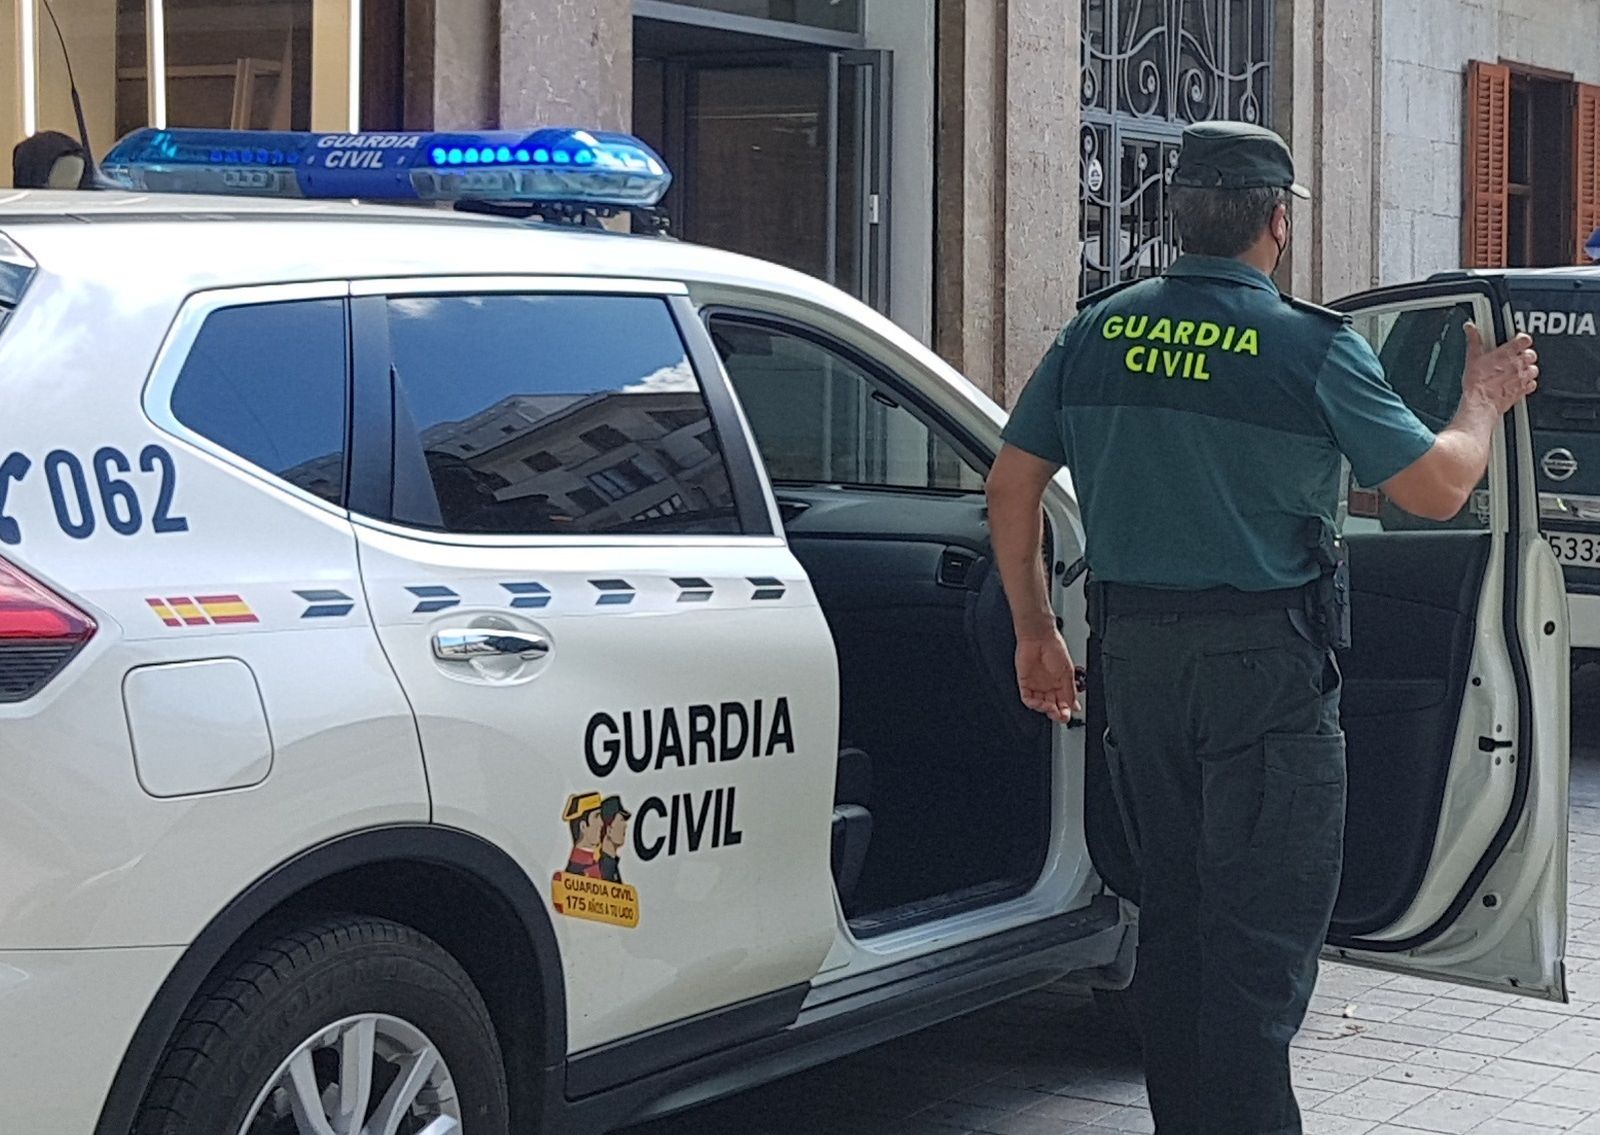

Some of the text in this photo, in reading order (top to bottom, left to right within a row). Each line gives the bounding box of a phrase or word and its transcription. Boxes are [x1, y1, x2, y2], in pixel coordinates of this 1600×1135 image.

[317, 135, 420, 148] GUARDIA
[325, 151, 383, 168] CIVIL
[1102, 315, 1259, 356] GUARDIA
[1125, 345, 1210, 380] CIVIL
[44, 444, 189, 540] 062
[584, 696, 795, 777] GUARDIA
[633, 786, 742, 862] CIVIL
[564, 878, 635, 902] GUARDIA CIVIL
[566, 895, 587, 911] 175
